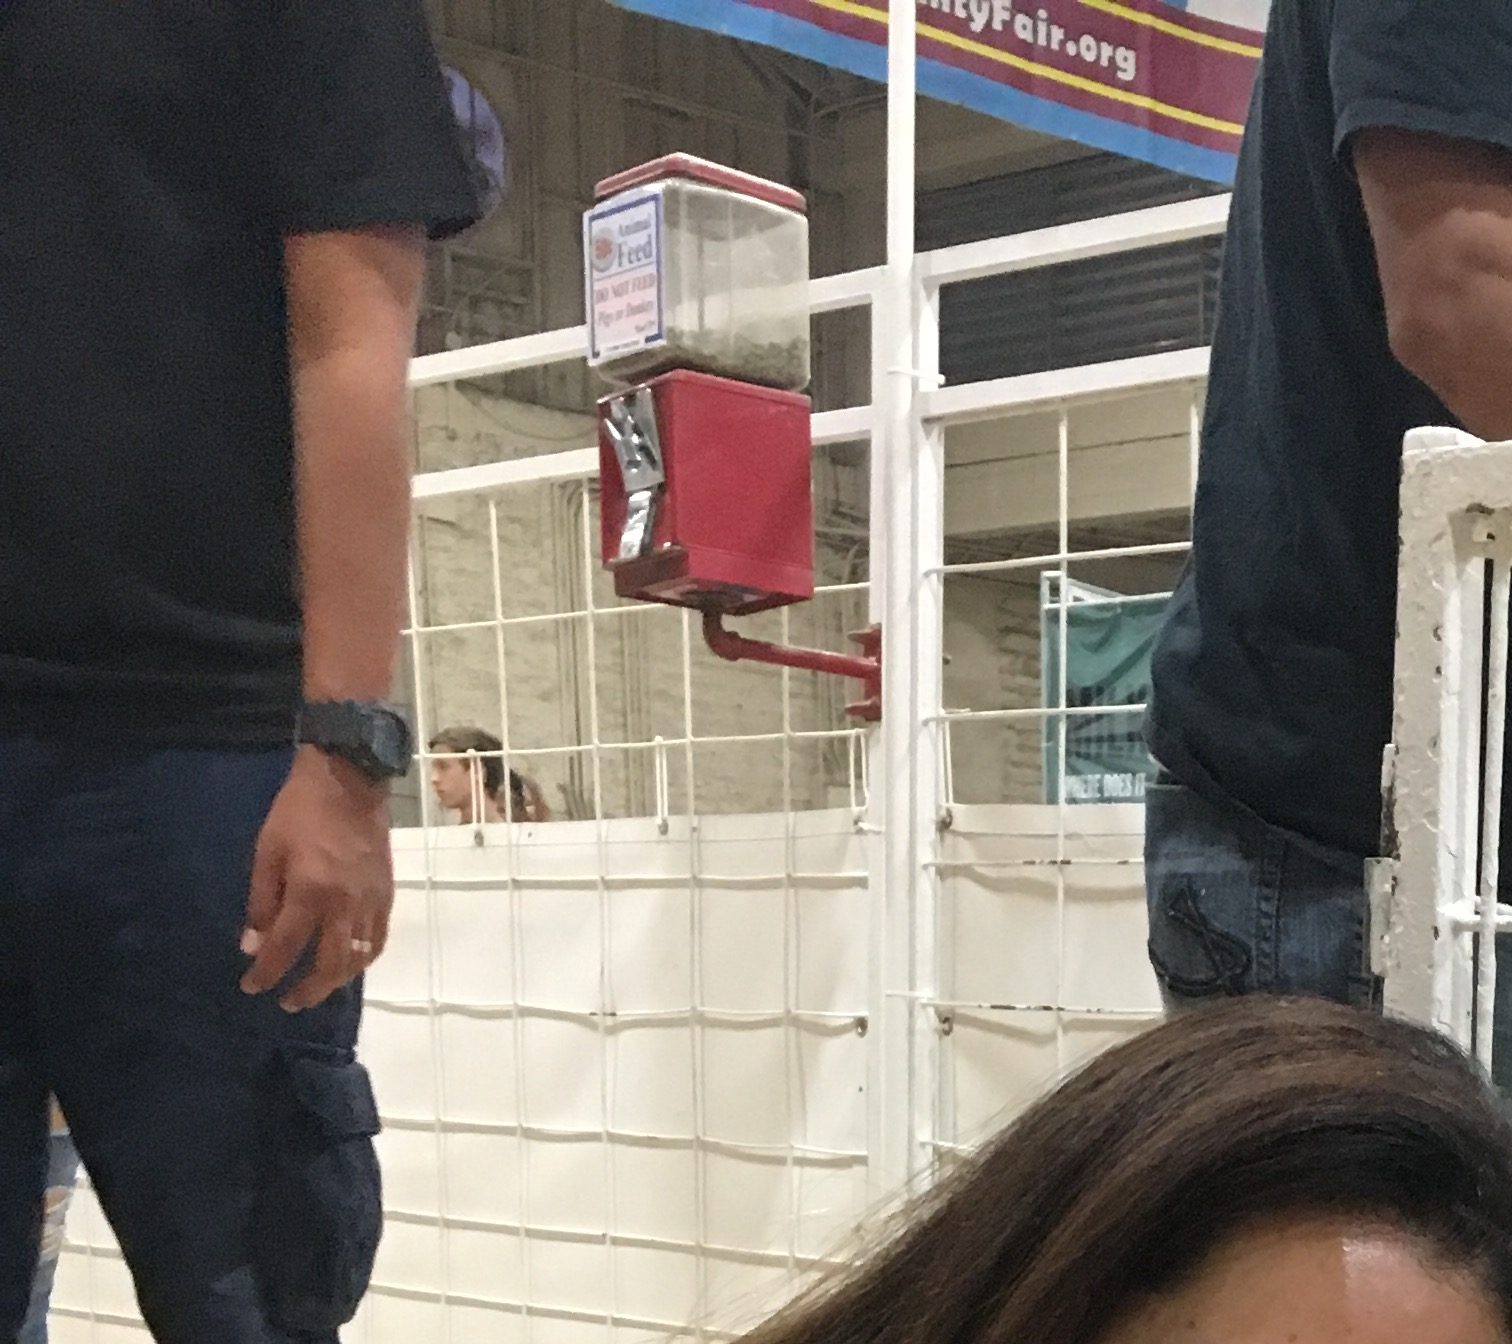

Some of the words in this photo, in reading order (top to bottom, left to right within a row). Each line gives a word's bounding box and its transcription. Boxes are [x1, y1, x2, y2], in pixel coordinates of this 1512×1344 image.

[916, 0, 1137, 82] ntyFair.org
[617, 233, 653, 268] Feed
[631, 272, 657, 294] FEED
